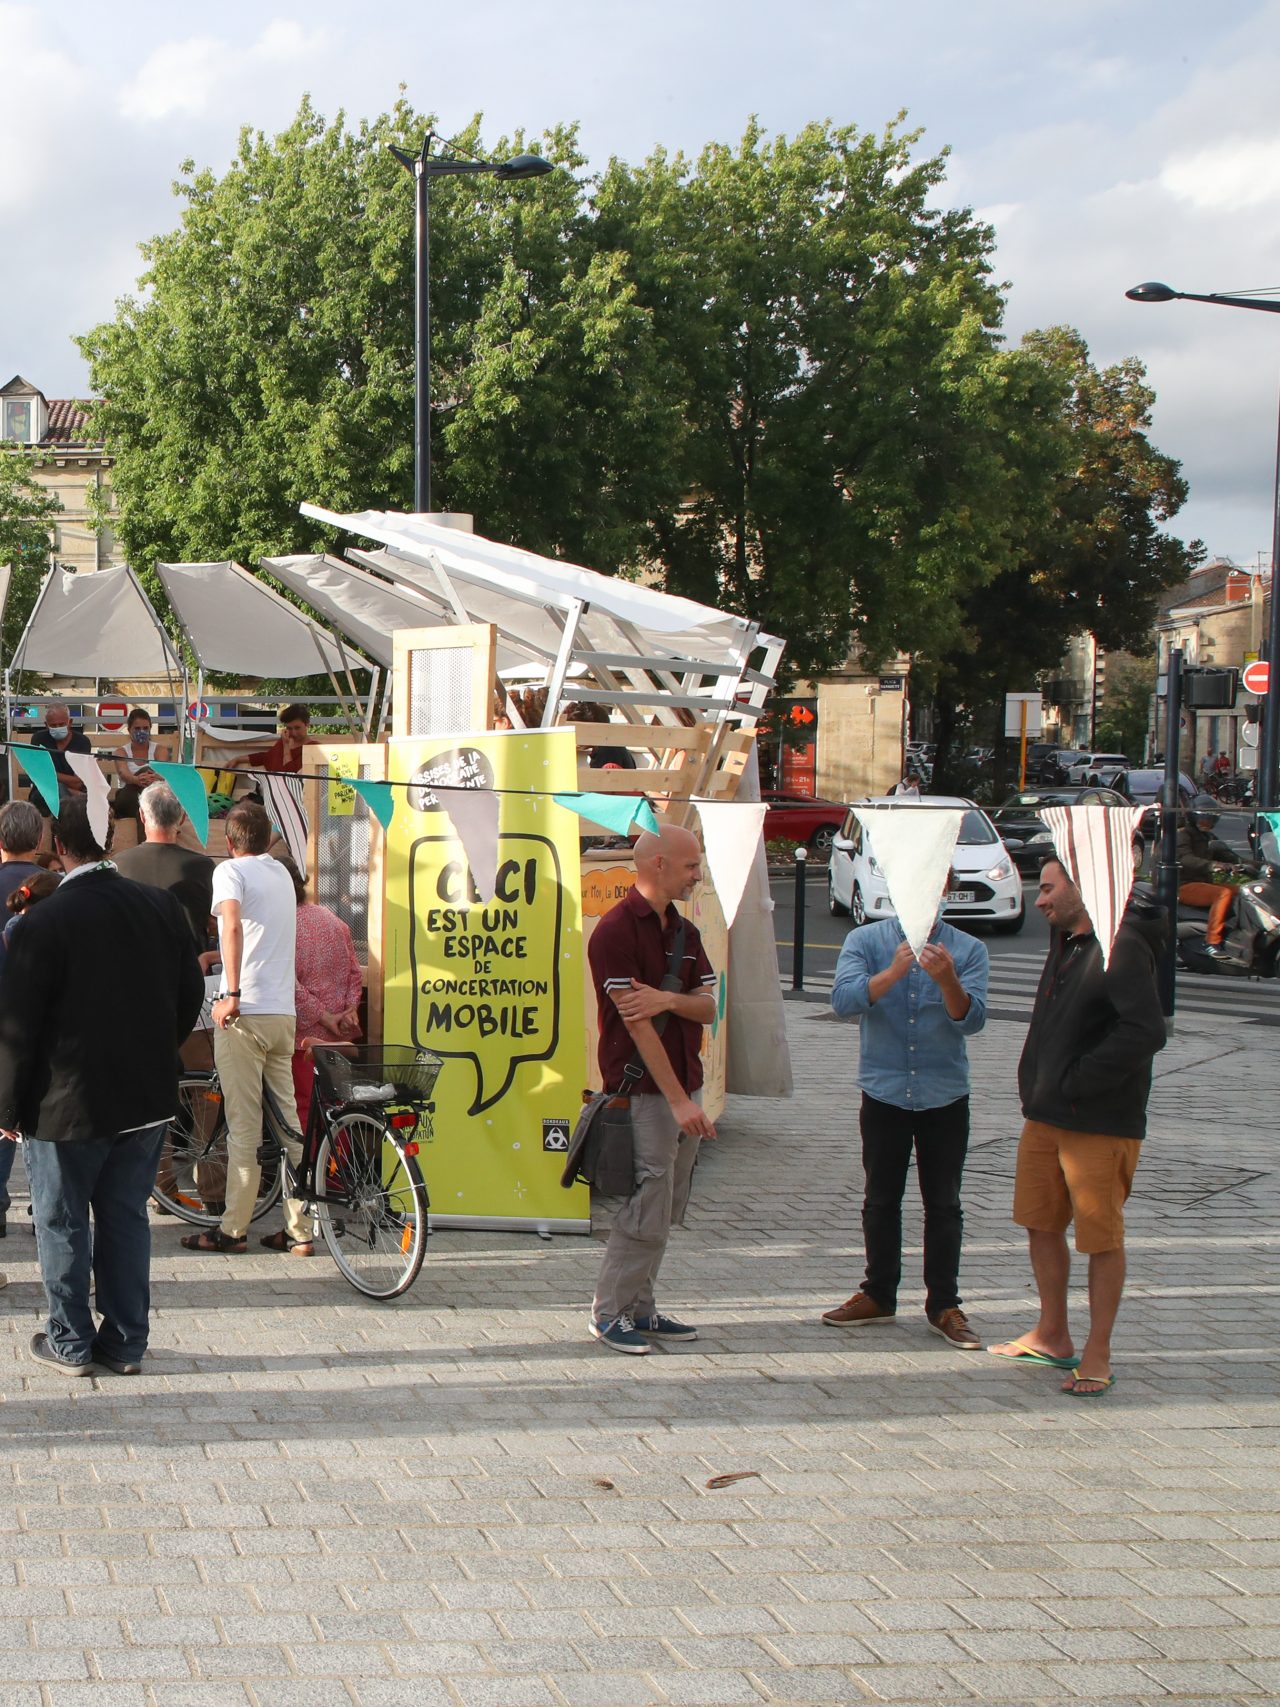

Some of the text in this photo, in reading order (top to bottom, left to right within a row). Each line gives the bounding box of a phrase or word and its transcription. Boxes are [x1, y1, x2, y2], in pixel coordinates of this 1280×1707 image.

[468, 751, 481, 765] LA
[427, 908, 518, 932] EST UN
[444, 934, 527, 960] ESPACE
[474, 960, 491, 974] DE
[421, 978, 548, 997] CONCERTATION
[426, 1002, 539, 1038] MOBILE
